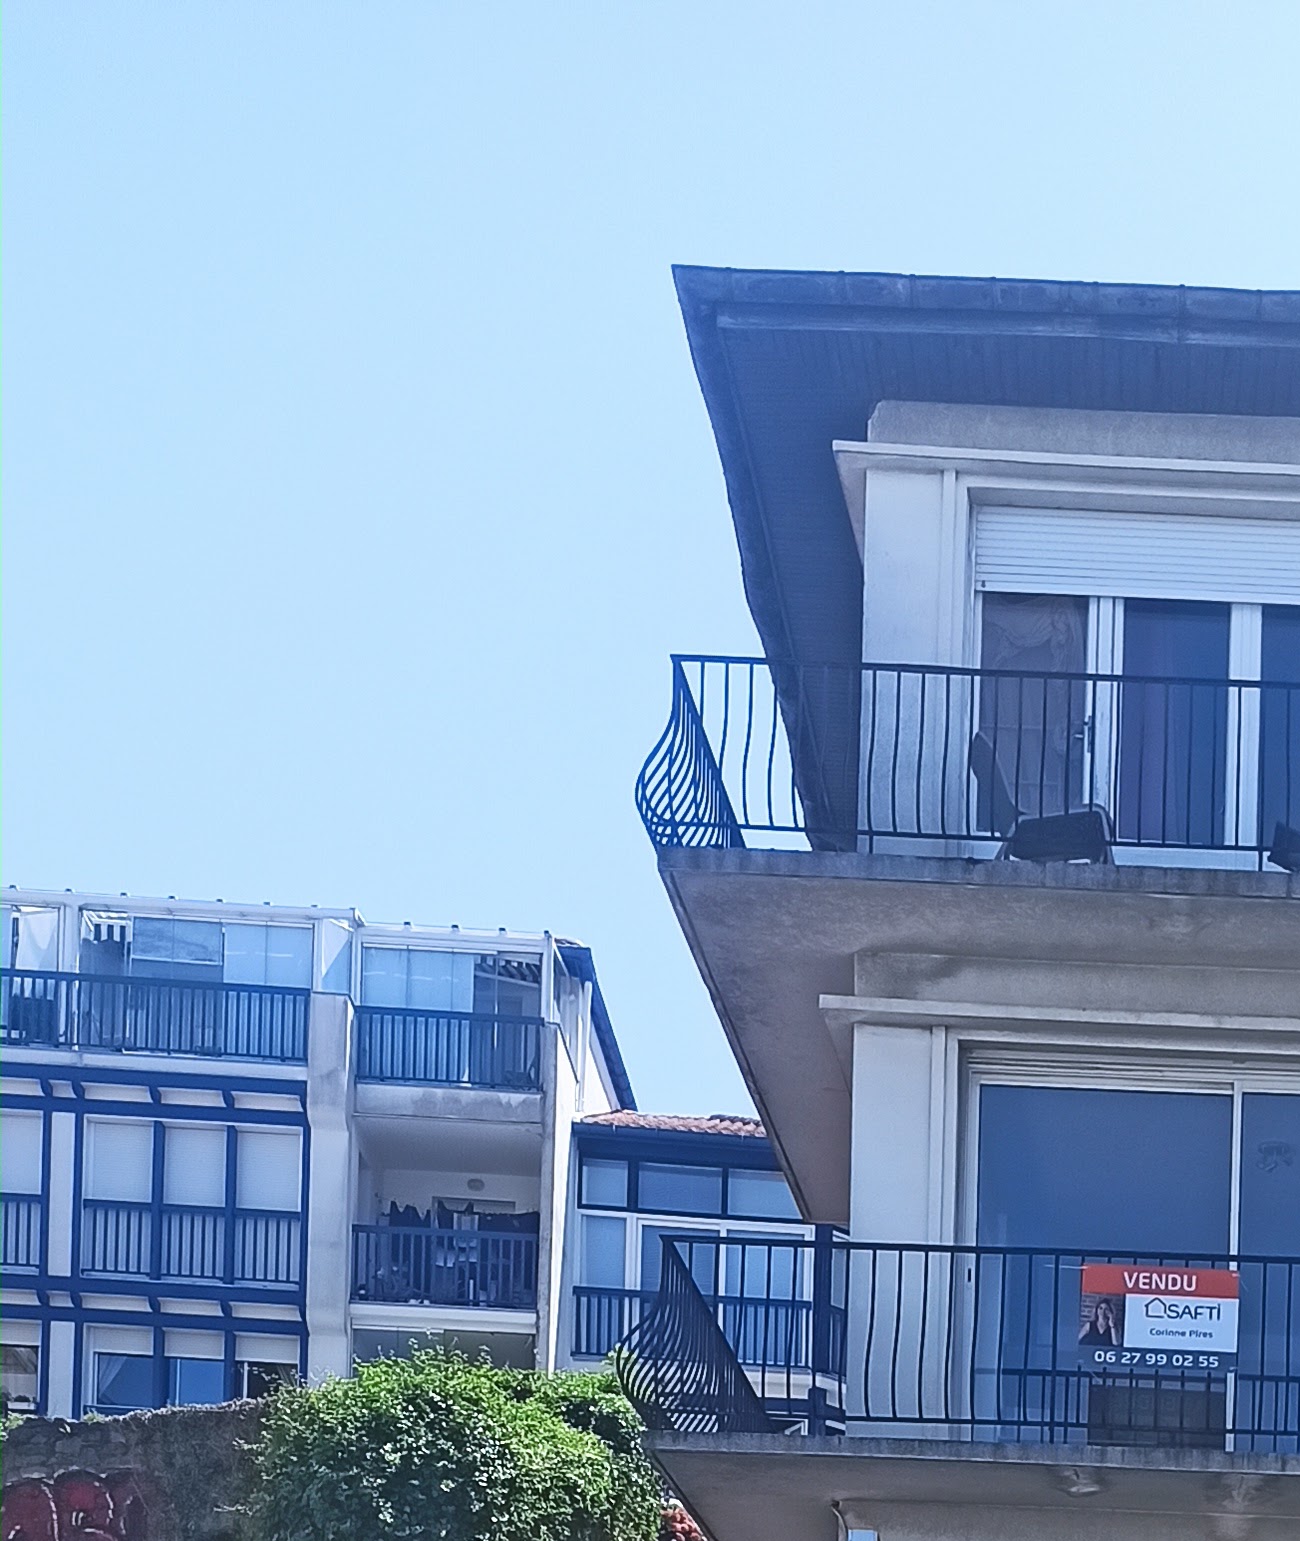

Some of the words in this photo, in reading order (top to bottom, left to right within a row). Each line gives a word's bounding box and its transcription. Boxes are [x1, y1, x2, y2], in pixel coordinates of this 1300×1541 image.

[1123, 1271, 1197, 1291] VENDU
[1167, 1303, 1220, 1321] SAFTI
[1150, 1327, 1186, 1338] Corinne
[1189, 1328, 1213, 1339] Pires
[1094, 1351, 1116, 1363] 06
[1121, 1352, 1141, 1364] 27
[1145, 1353, 1166, 1365] 99
[1172, 1354, 1193, 1366] 02
[1198, 1355, 1219, 1367] 55
